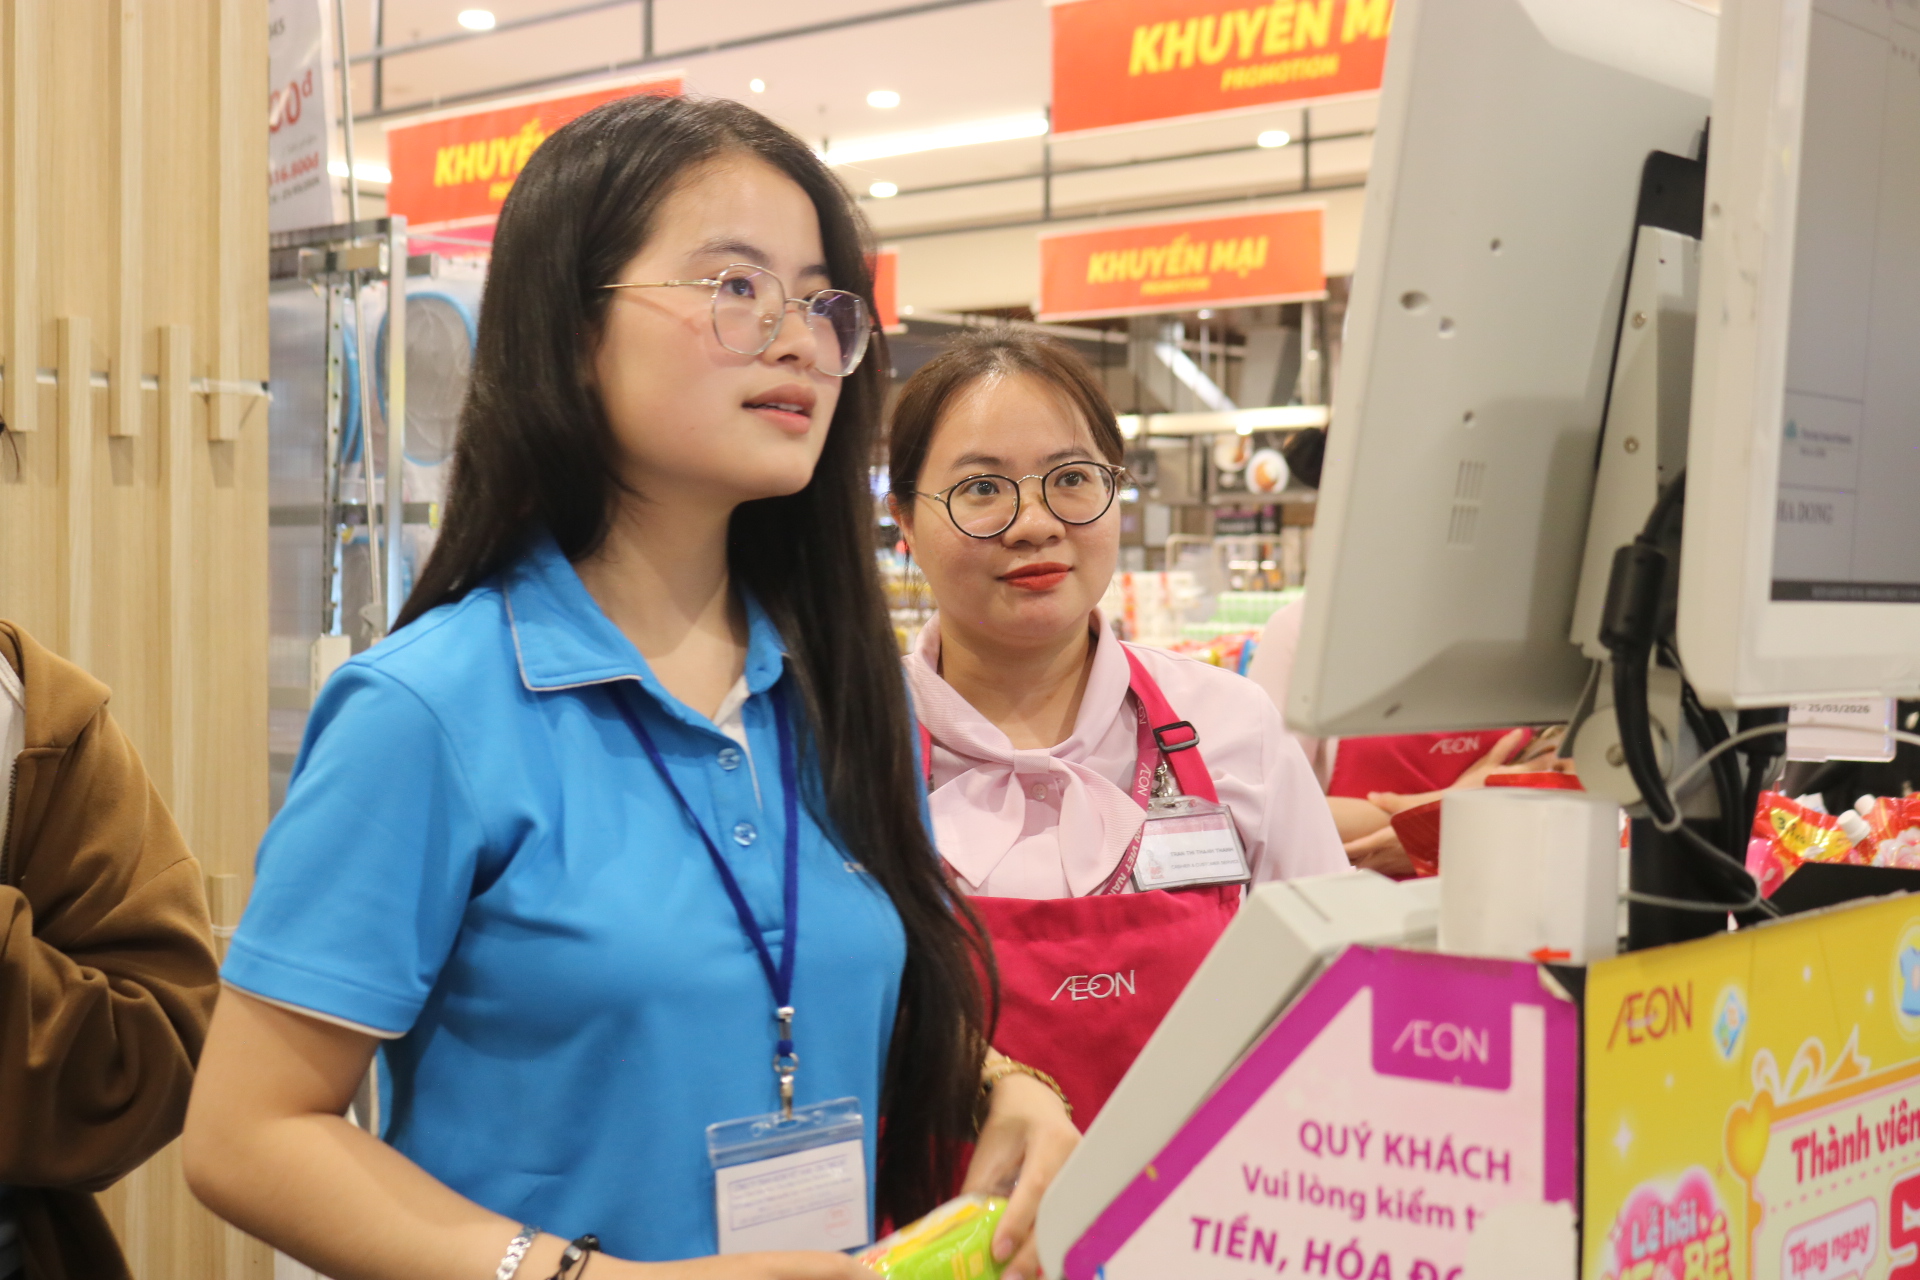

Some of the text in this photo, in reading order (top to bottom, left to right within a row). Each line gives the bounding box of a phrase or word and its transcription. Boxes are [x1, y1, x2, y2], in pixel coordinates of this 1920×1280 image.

[1340, 0, 1395, 44] M
[434, 117, 557, 188] KHUYẾ
[1087, 232, 1269, 284] KHUYẾN MẠI
[1808, 703, 1870, 714] 25/03/2026
[1124, 845, 1139, 873] VIET
[1383, 1131, 1511, 1184] KHÁCH
[1791, 1112, 1870, 1184] Thành
[1240, 1162, 1288, 1200] Vui
[1298, 1170, 1367, 1222] lòng
[1302, 1236, 1392, 1280] HÓA
